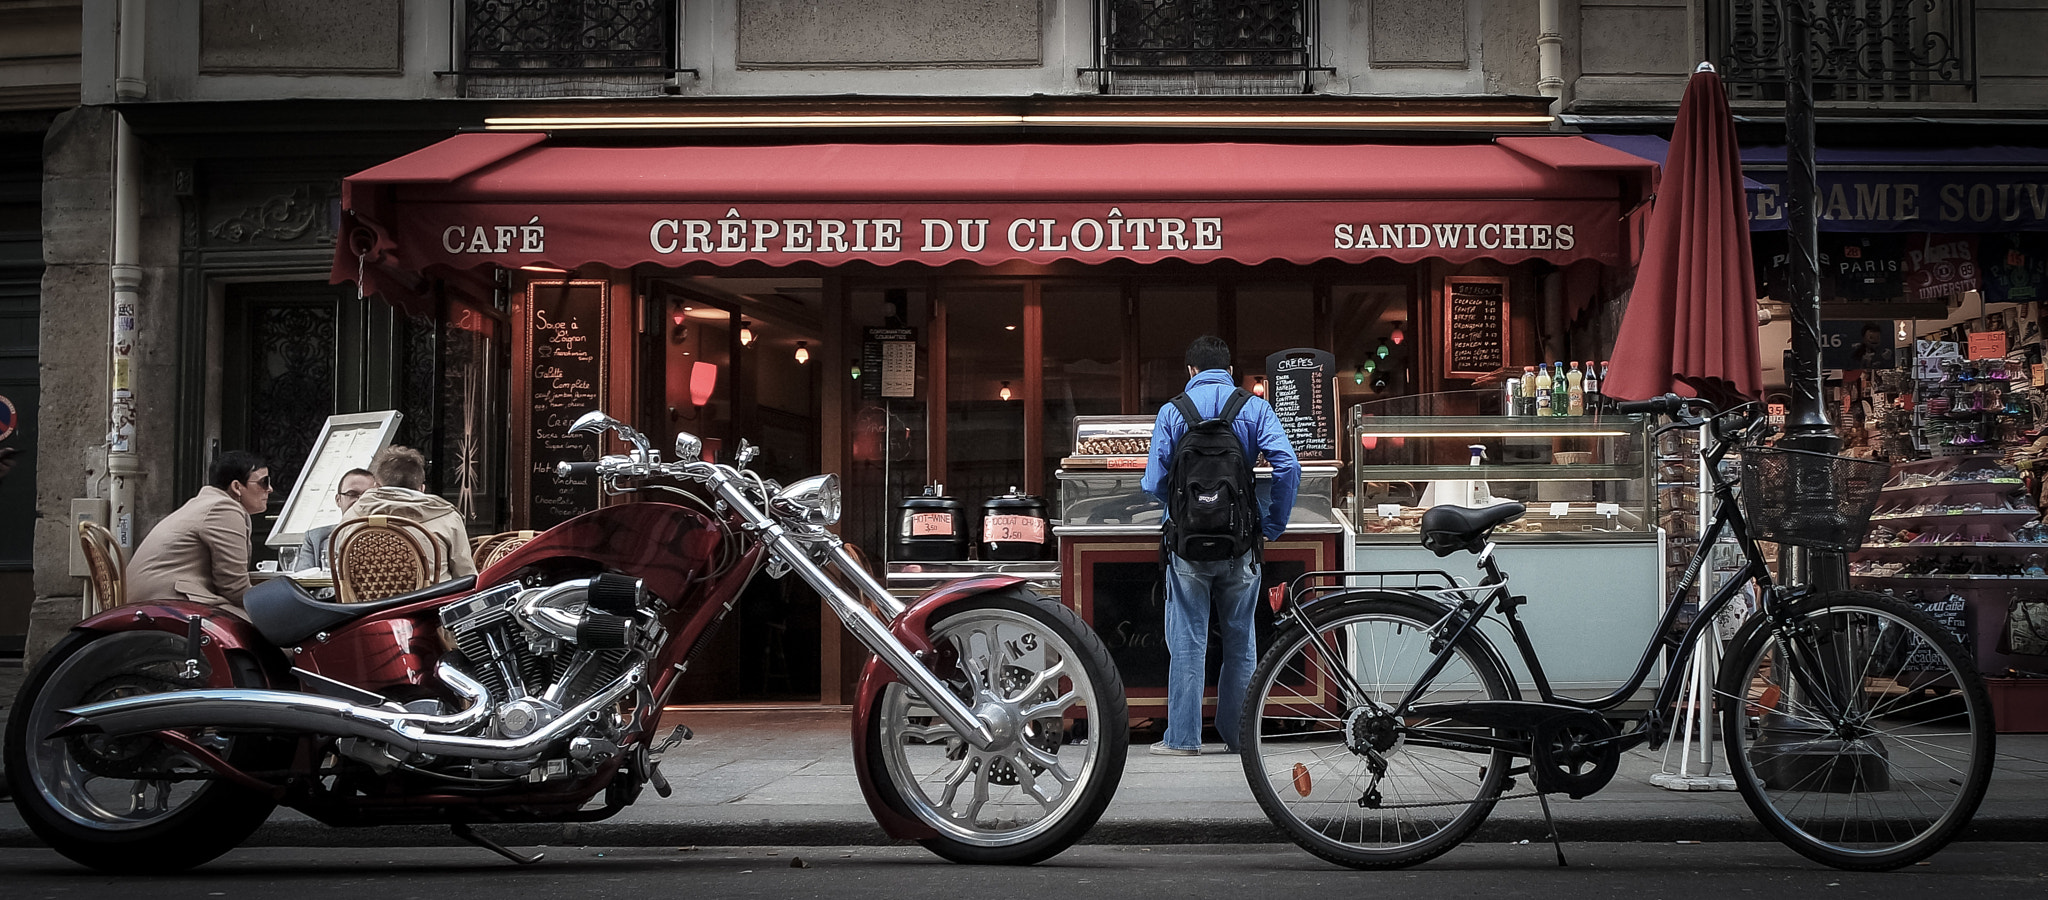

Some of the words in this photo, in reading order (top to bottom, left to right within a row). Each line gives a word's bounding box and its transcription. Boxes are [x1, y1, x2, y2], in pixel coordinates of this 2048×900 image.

[443, 215, 545, 254] CAFÉ
[650, 208, 902, 254] CRÊPERIE
[921, 219, 989, 252] DU
[1006, 206, 1224, 252] CLOÎTRE
[1334, 223, 1575, 250] SANDWICHES
[1840, 259, 1898, 274] PARIS
[1960, 264, 1973, 275] 89
[1919, 278, 1977, 300] UNIVERSITY
[533, 462, 553, 474] Hot
